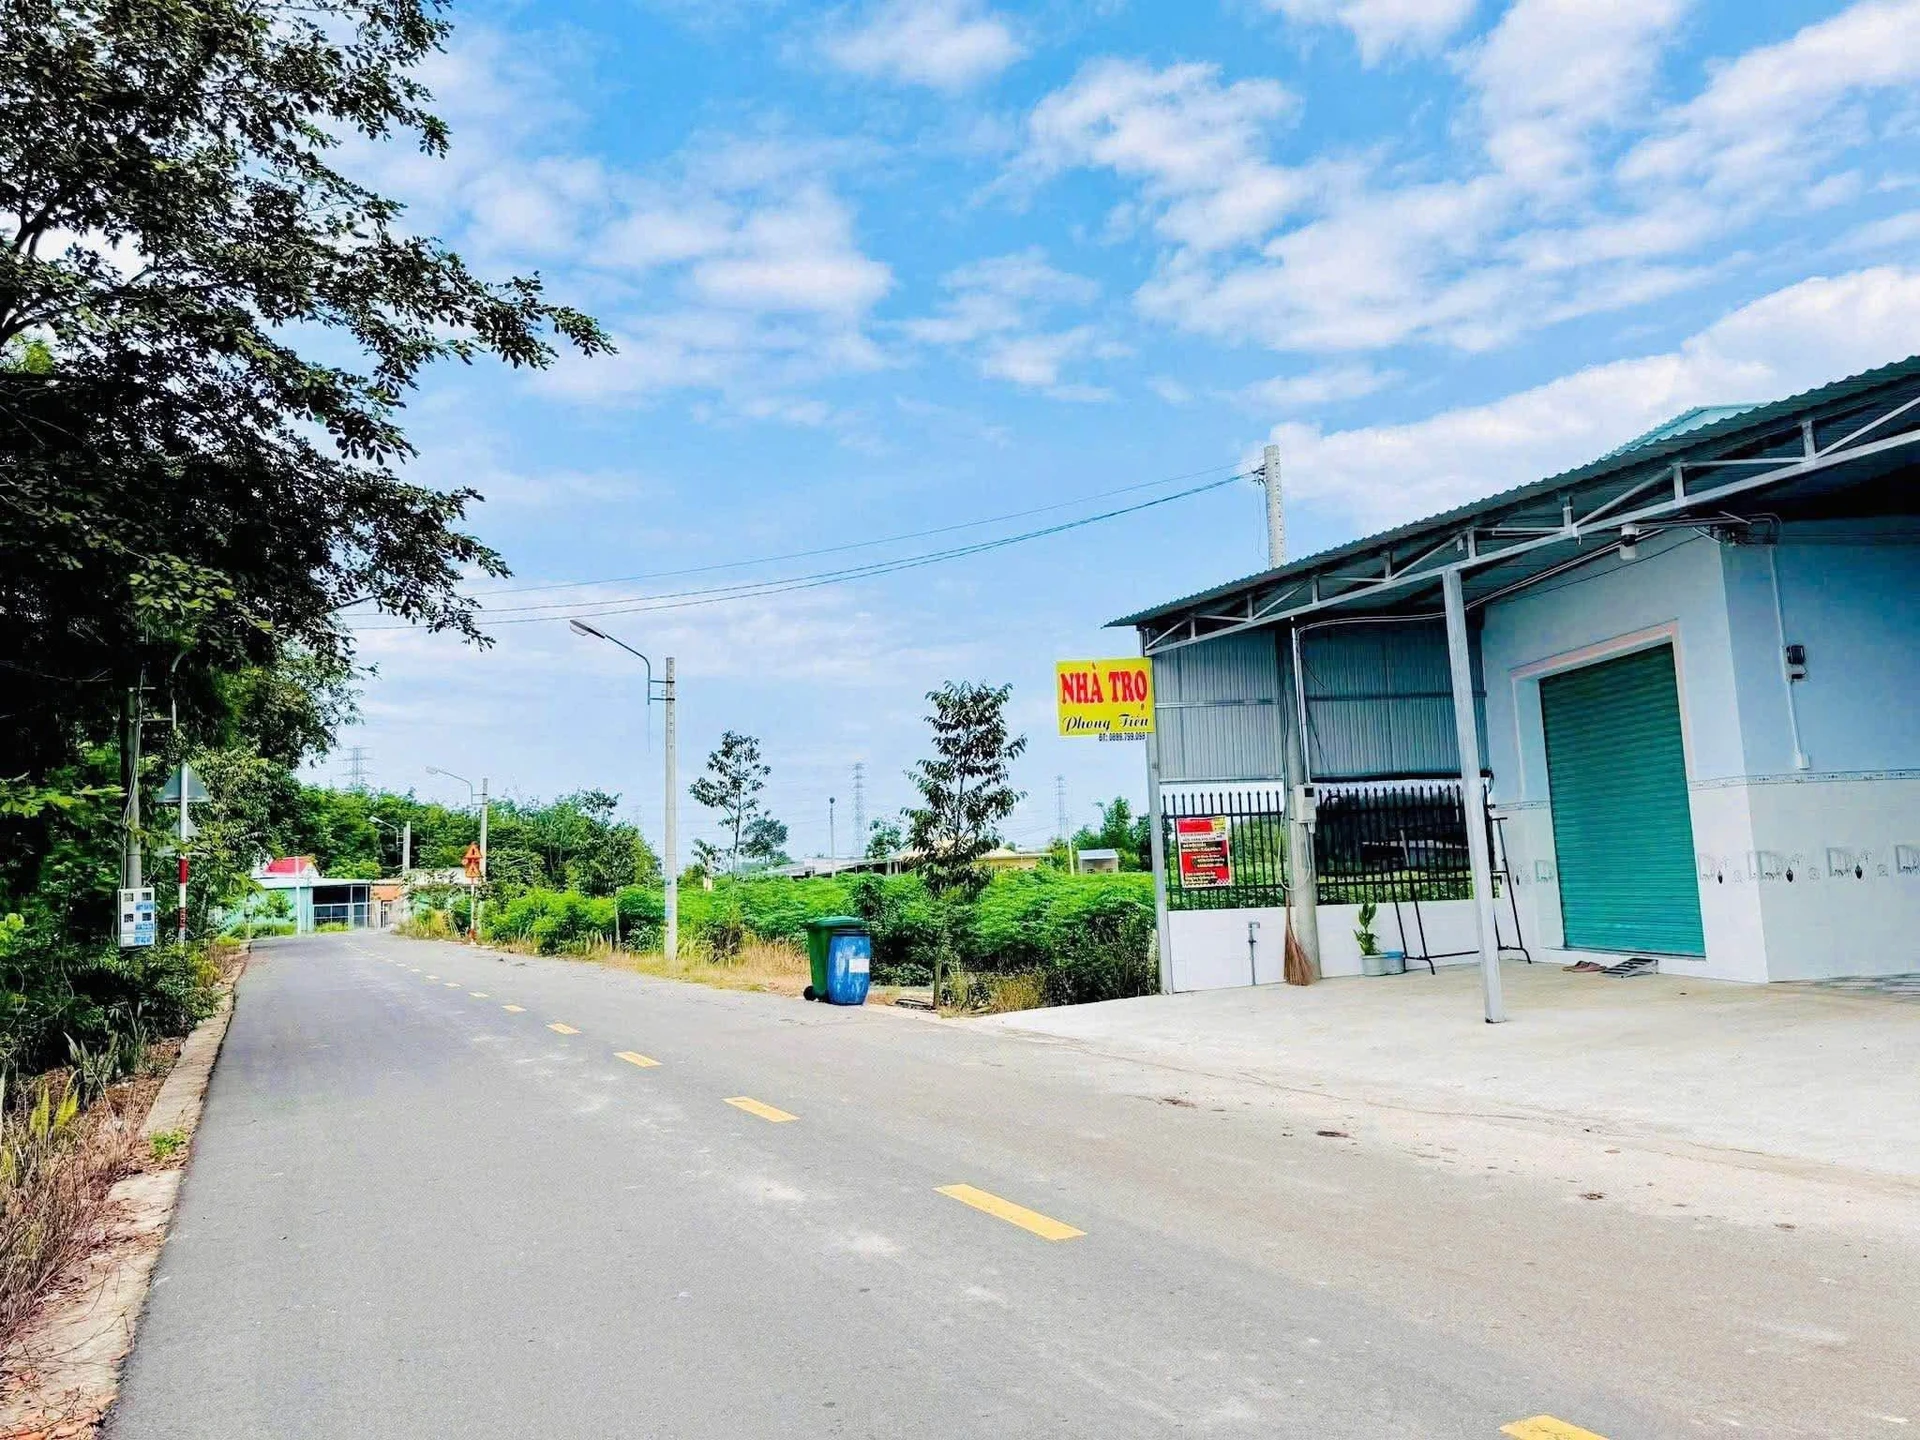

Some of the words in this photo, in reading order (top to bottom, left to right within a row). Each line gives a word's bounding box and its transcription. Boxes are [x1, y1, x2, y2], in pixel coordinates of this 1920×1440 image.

[1060, 662, 1104, 704] NHÀ
[1108, 669, 1148, 711] TRỌ
[1062, 715, 1111, 732] Phong
